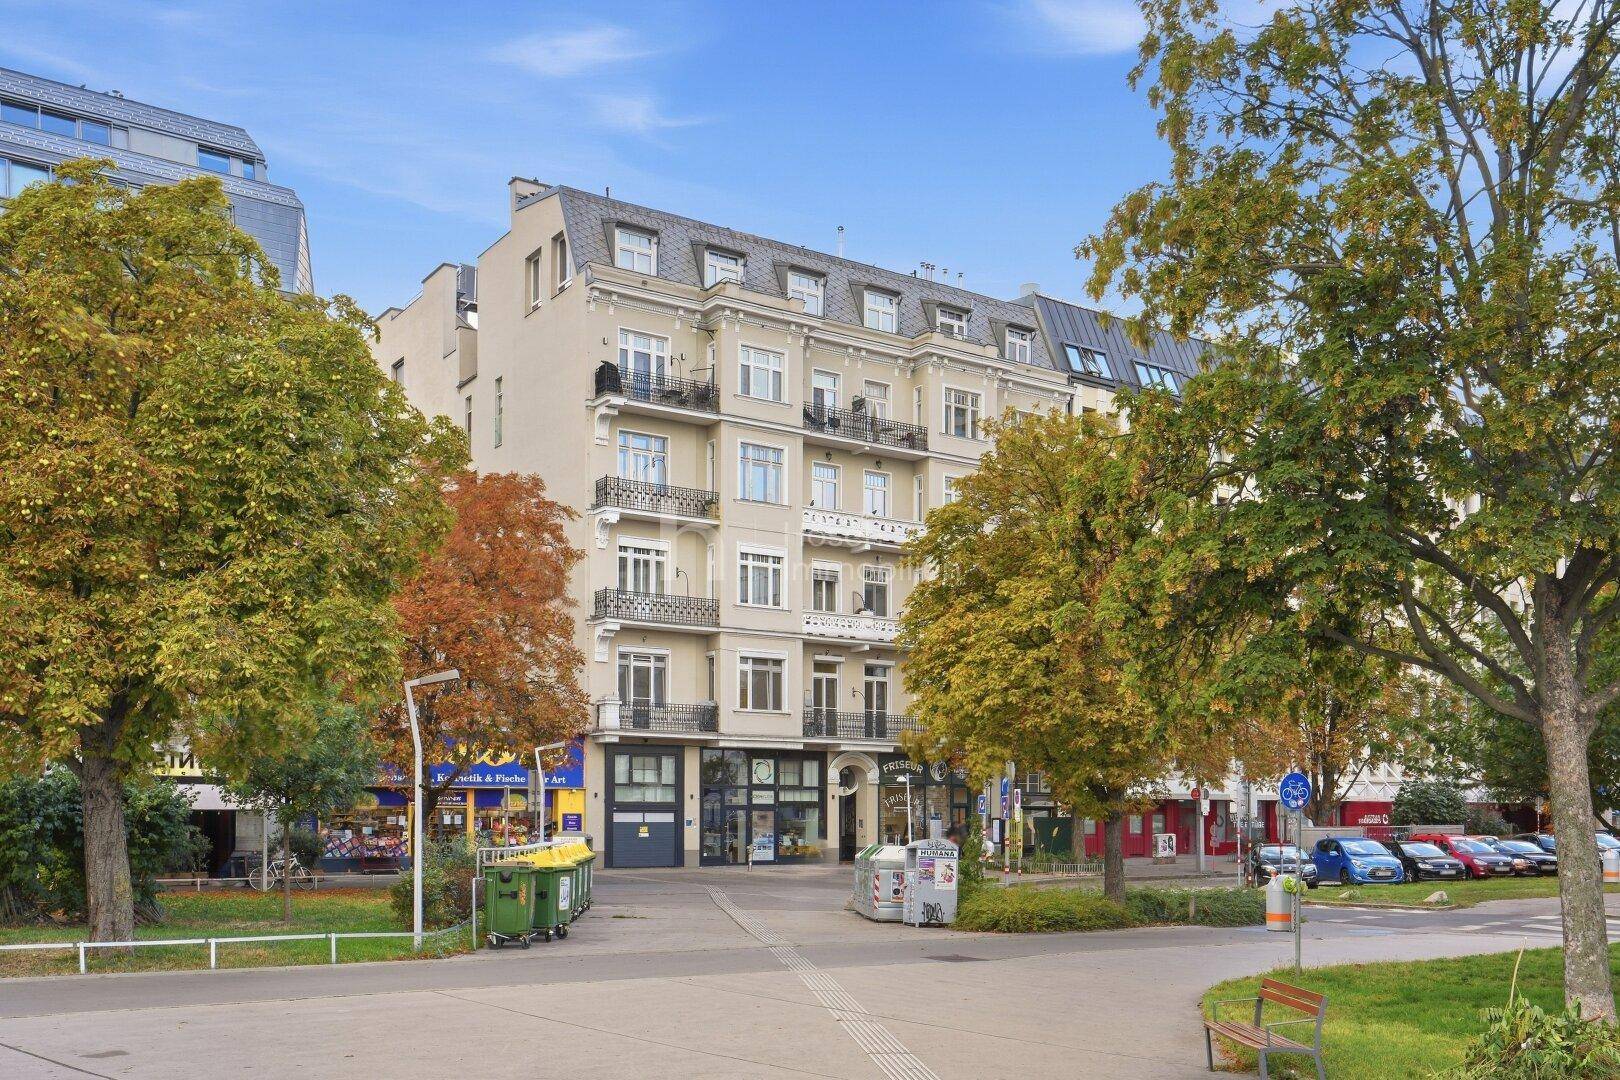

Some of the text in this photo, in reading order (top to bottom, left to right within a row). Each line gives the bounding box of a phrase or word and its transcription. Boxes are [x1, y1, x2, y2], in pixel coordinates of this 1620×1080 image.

[882, 760, 924, 774] FRISEUR
[437, 773, 482, 783] Kometik
[484, 773, 493, 783] &
[495, 773, 526, 783] Fische
[551, 775, 567, 784] Art
[884, 792, 920, 808] FRISEUR
[920, 849, 955, 857] HUMANA
